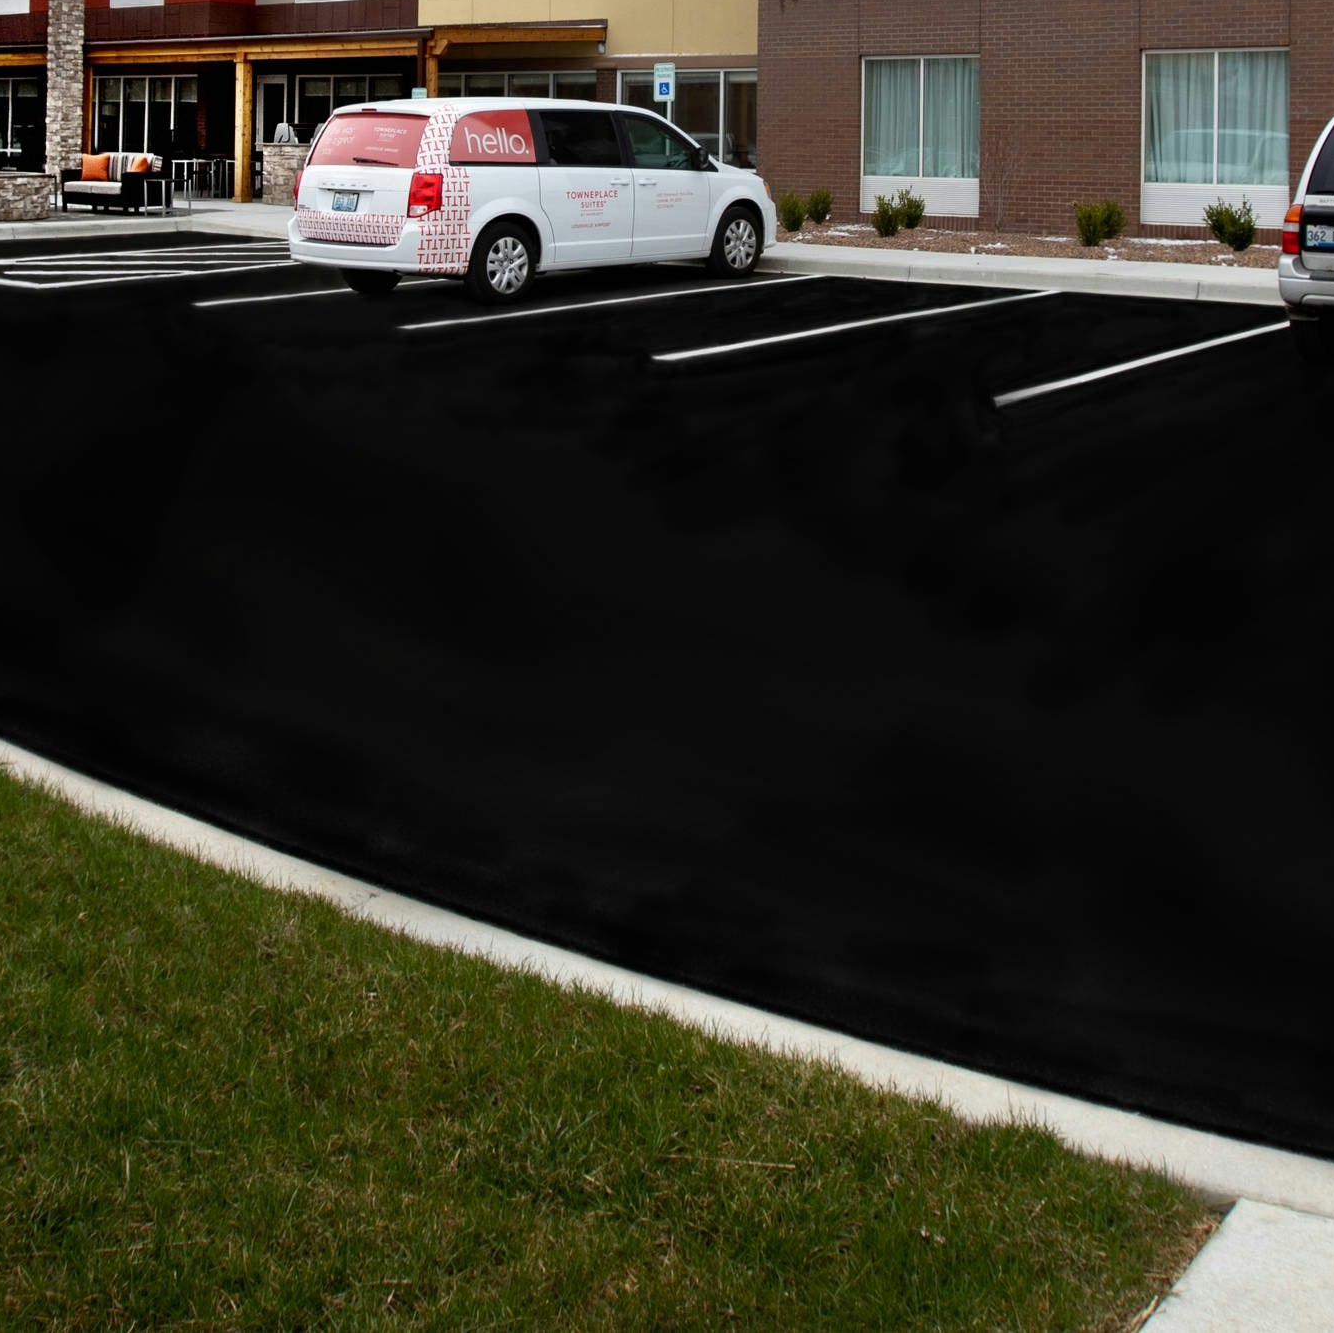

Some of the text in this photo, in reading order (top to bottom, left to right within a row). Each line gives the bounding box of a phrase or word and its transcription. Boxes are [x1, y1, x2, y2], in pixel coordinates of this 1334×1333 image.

[464, 126, 530, 155] hello.
[566, 189, 619, 199] TOWNEPLACE
[1307, 230, 1326, 242] 362
